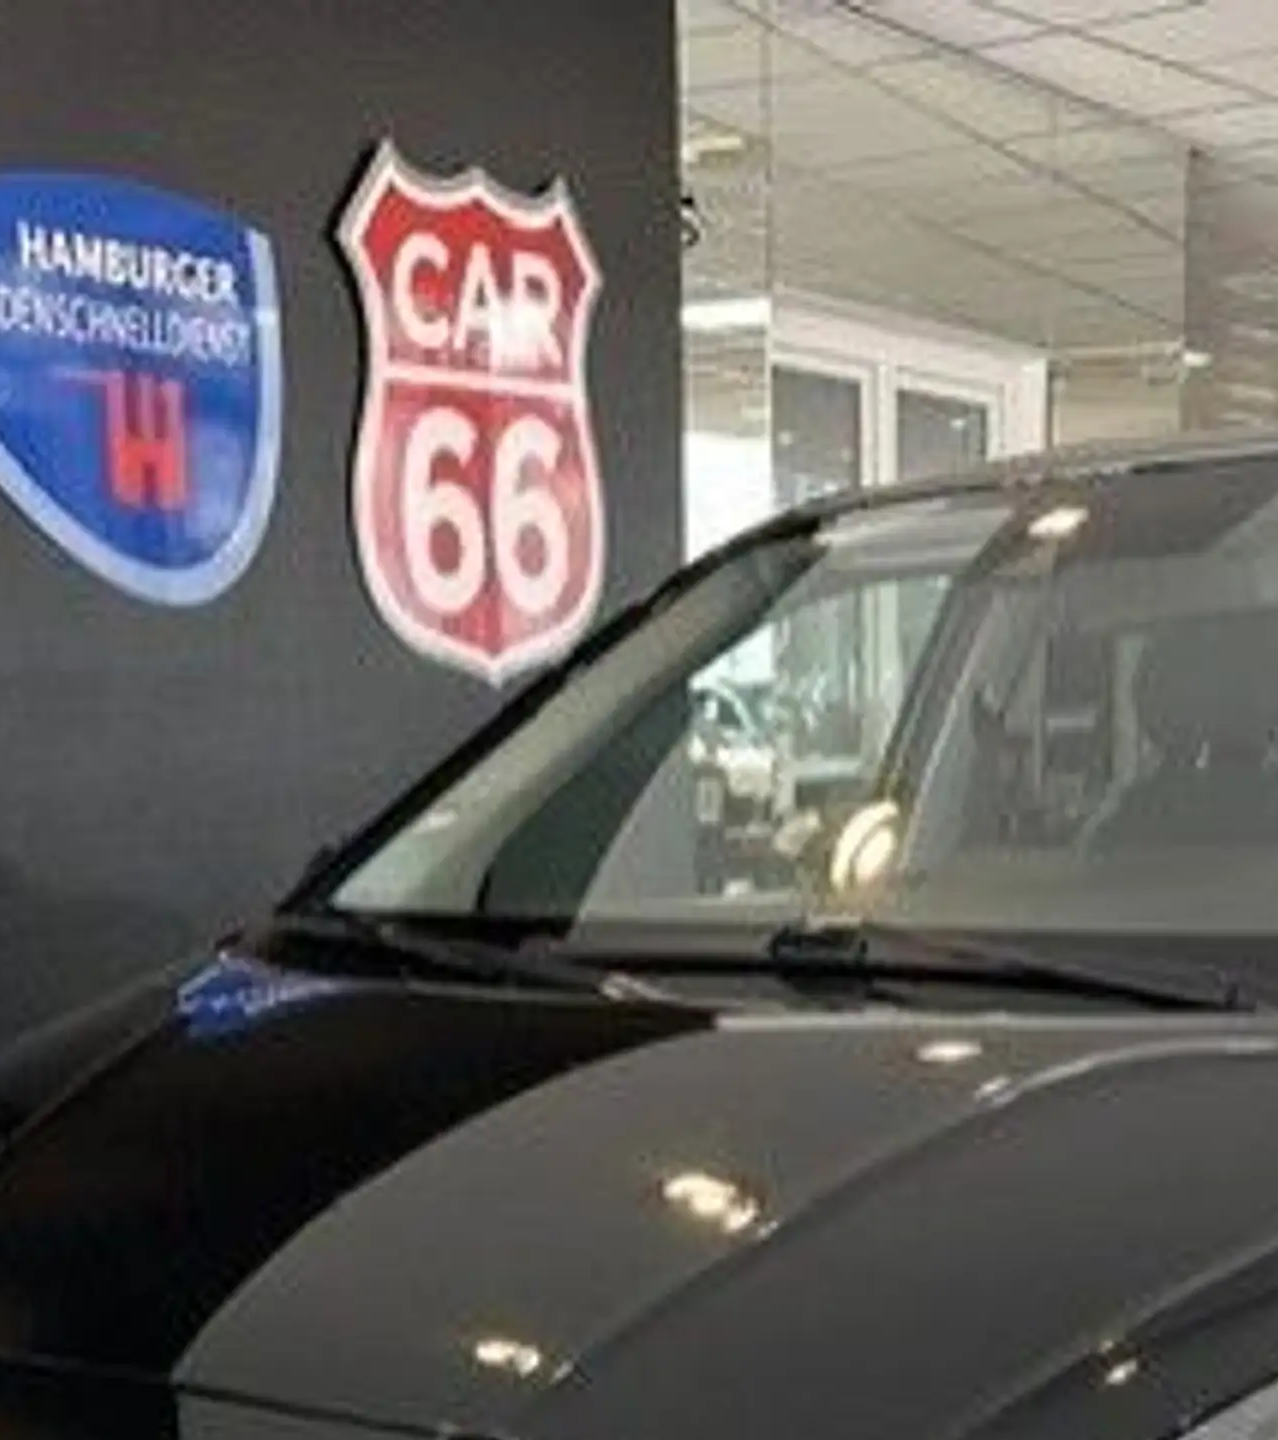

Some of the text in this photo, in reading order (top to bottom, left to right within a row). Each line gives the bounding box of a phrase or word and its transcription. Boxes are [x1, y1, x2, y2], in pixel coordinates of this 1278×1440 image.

[16, 219, 238, 306] HAMBURGER
[392, 233, 563, 368] CAR
[404, 406, 569, 614] 66
